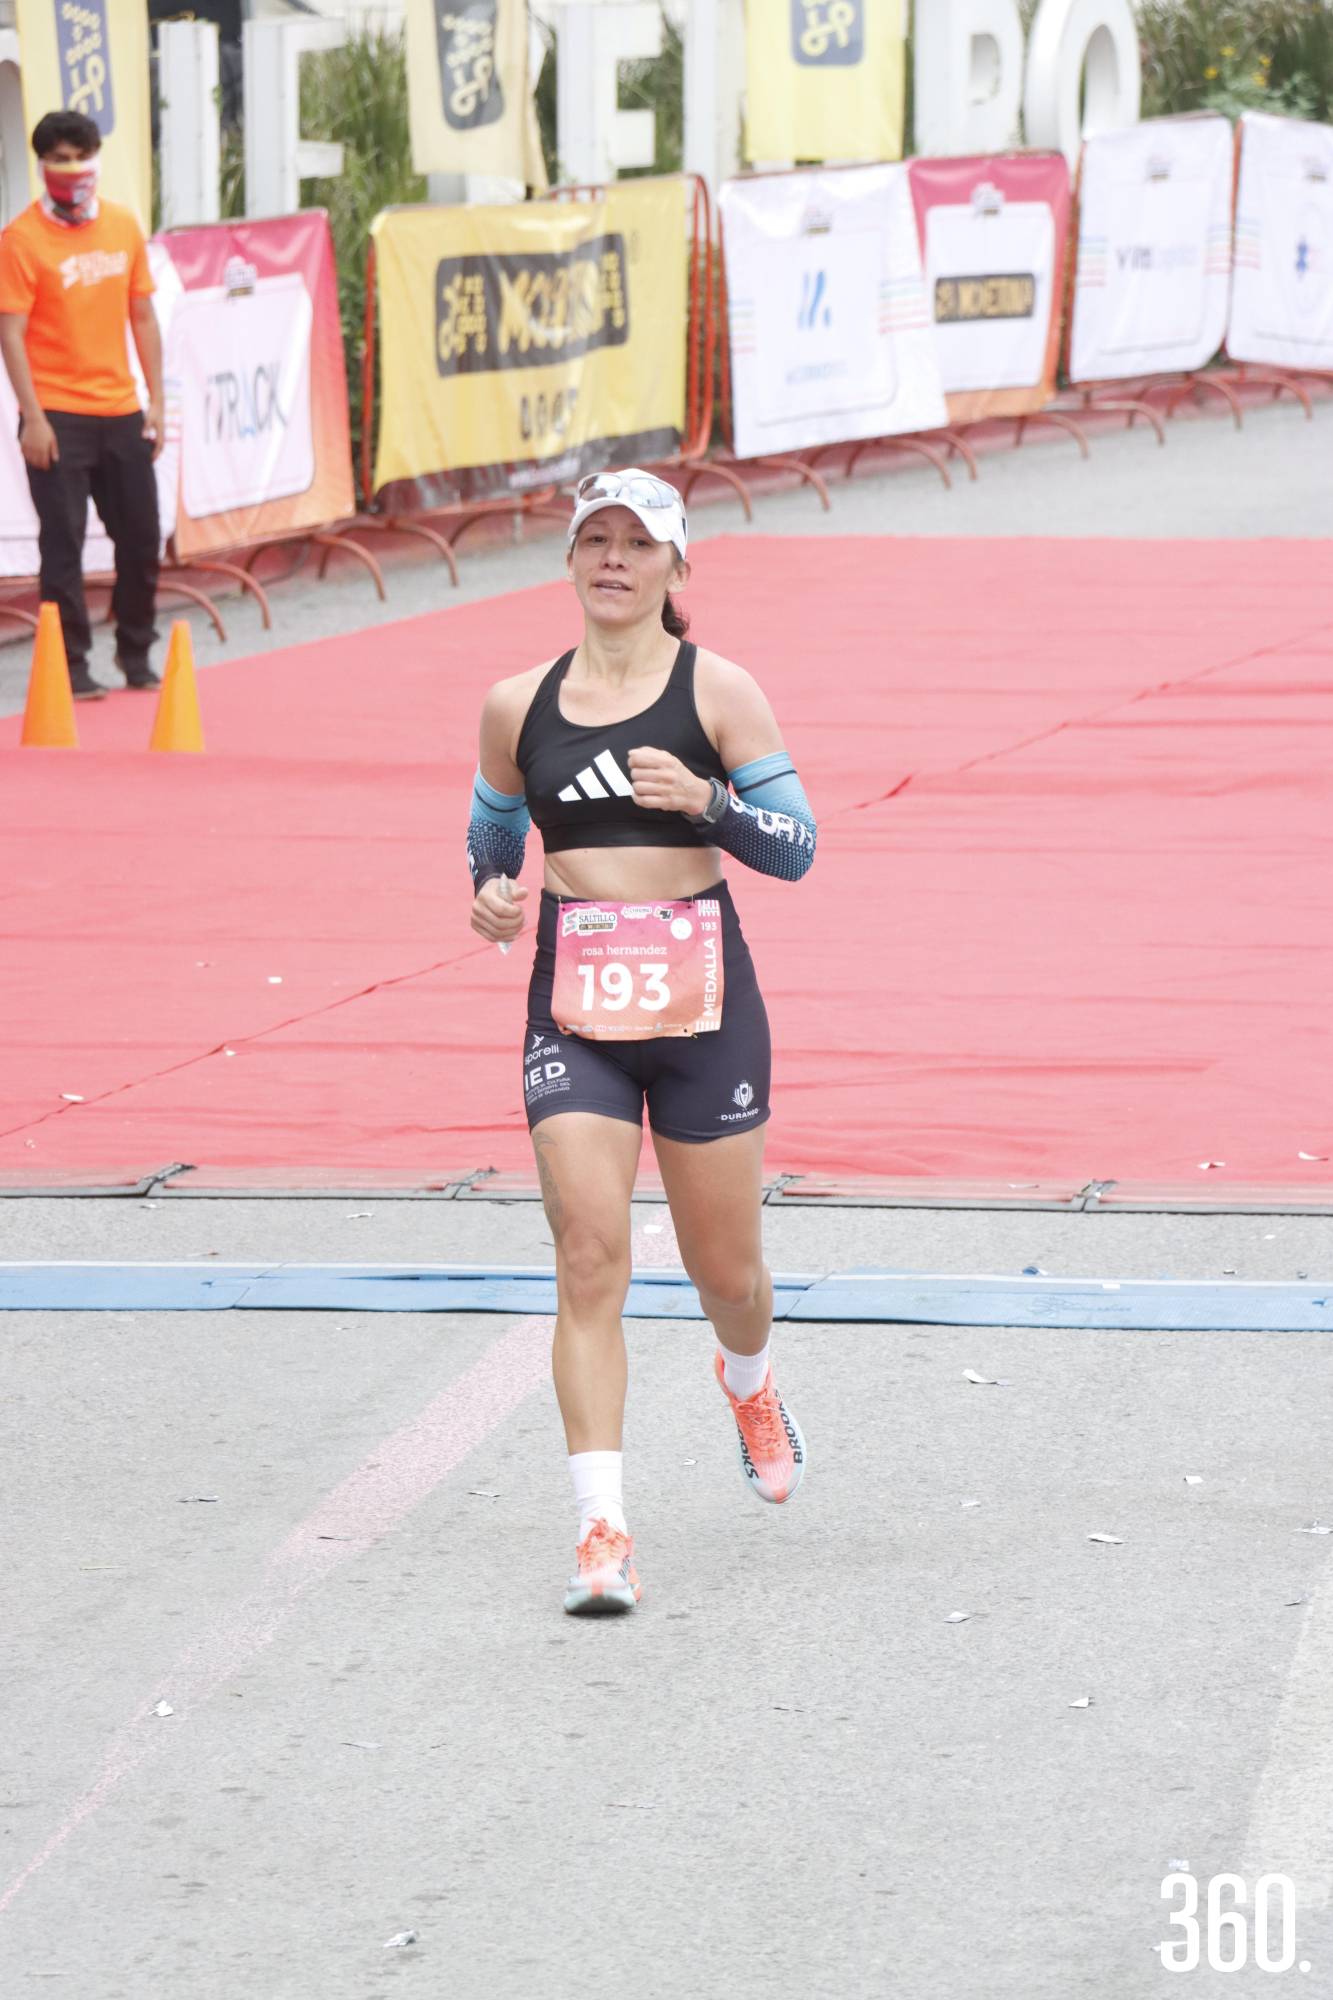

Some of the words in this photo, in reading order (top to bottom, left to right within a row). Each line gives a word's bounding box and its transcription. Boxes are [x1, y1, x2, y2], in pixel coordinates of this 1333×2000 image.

[578, 914, 616, 923] SALTILLO
[701, 921, 718, 931] 193
[581, 947, 604, 957] rosa
[606, 944, 668, 956] hernandez
[702, 937, 718, 1017] MEDALLA
[577, 962, 671, 1012] 193
